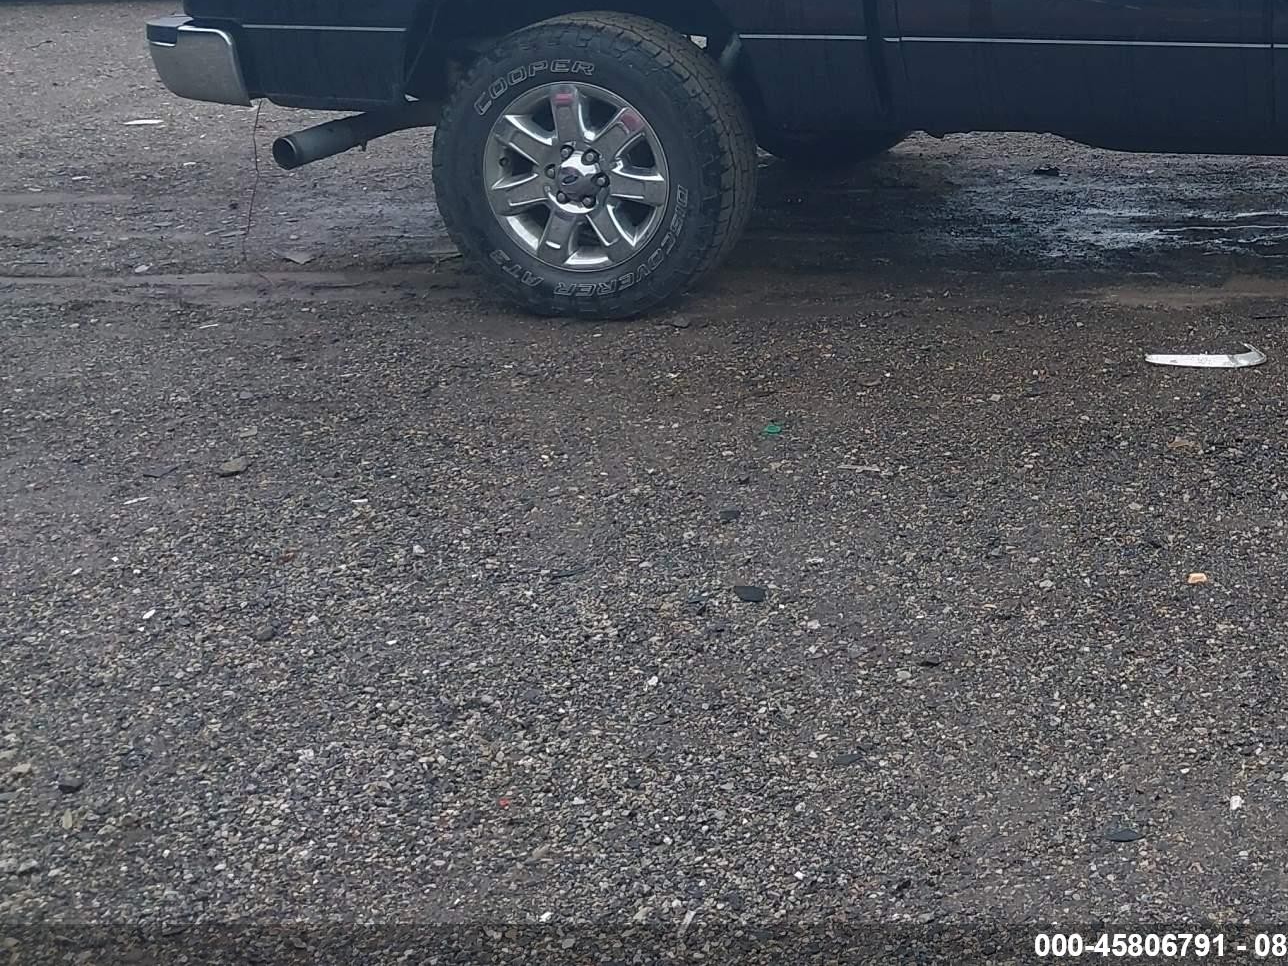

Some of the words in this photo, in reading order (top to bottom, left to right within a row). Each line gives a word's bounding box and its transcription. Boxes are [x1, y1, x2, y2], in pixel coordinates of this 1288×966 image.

[473, 59, 595, 116] COOPER
[489, 248, 545, 288] AT3
[553, 184, 689, 297] DISCOVERER
